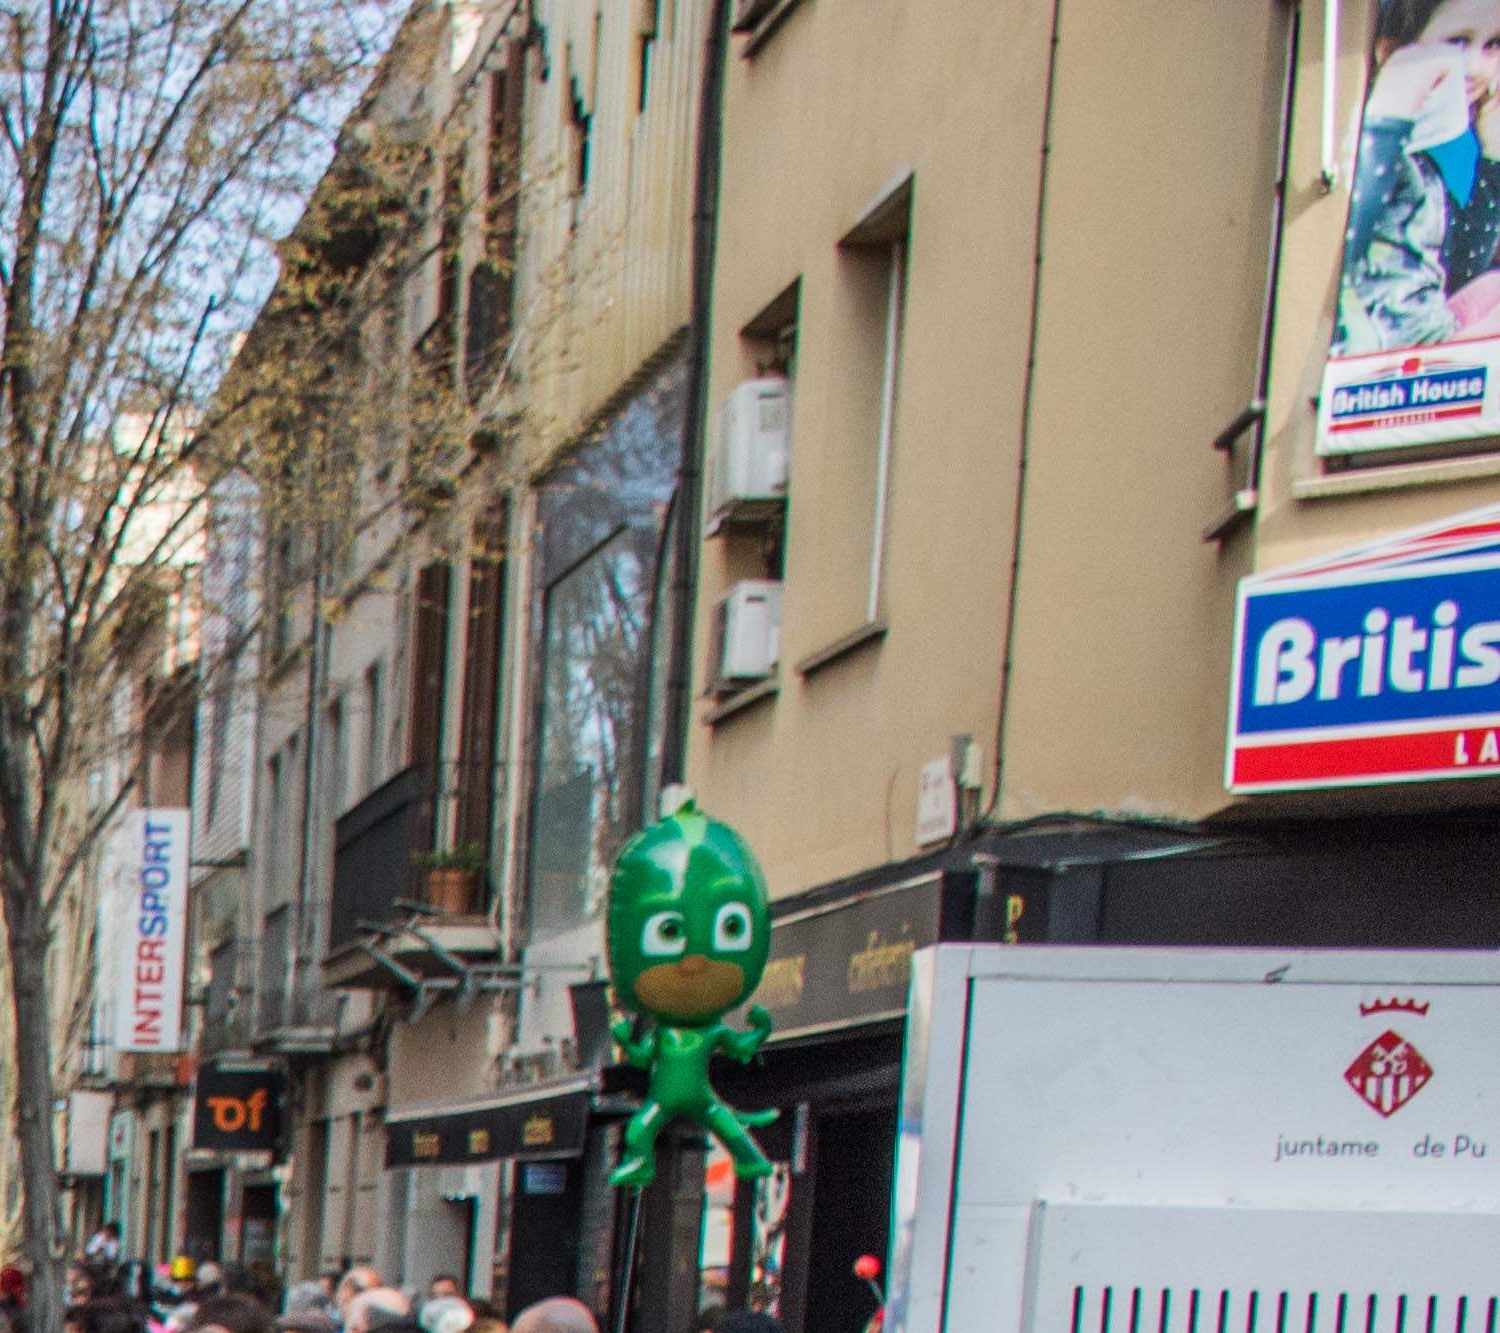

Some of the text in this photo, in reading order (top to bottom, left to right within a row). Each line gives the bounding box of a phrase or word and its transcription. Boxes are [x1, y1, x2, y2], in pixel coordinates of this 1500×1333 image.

[1411, 377, 1484, 403] House
[132, 820, 173, 1046] INTERSPORT
[1413, 1133, 1446, 1158] de
